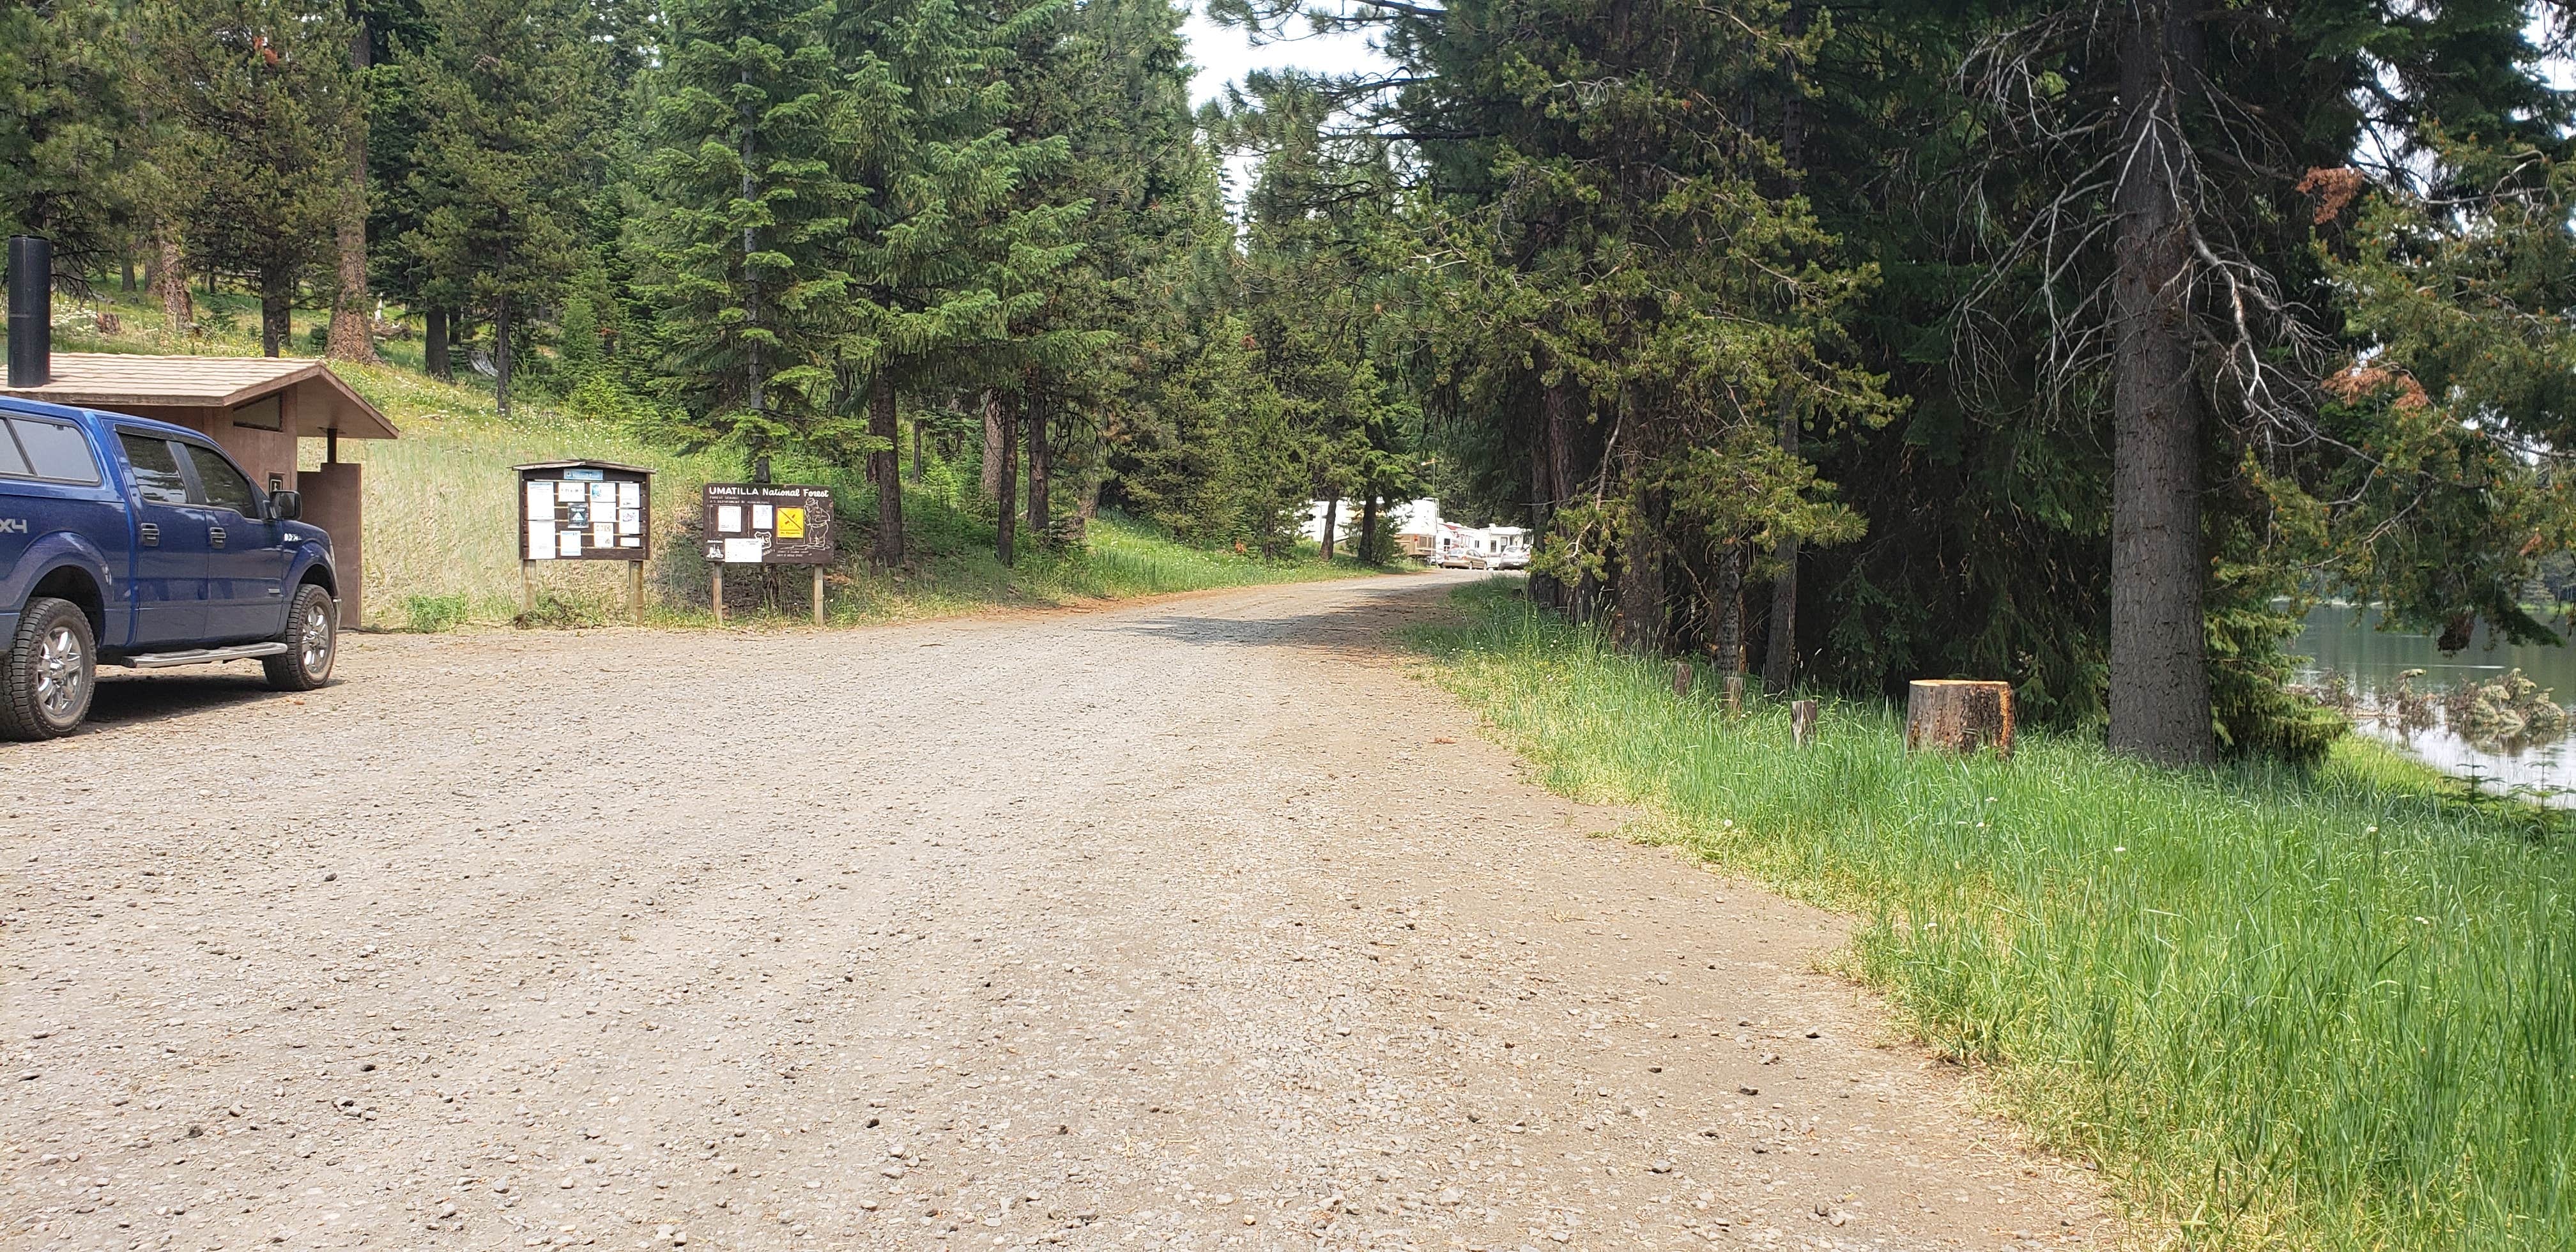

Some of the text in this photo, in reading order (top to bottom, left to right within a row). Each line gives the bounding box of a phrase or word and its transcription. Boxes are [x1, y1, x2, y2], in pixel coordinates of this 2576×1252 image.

[709, 487, 829, 498] UMATILLA National Forest
